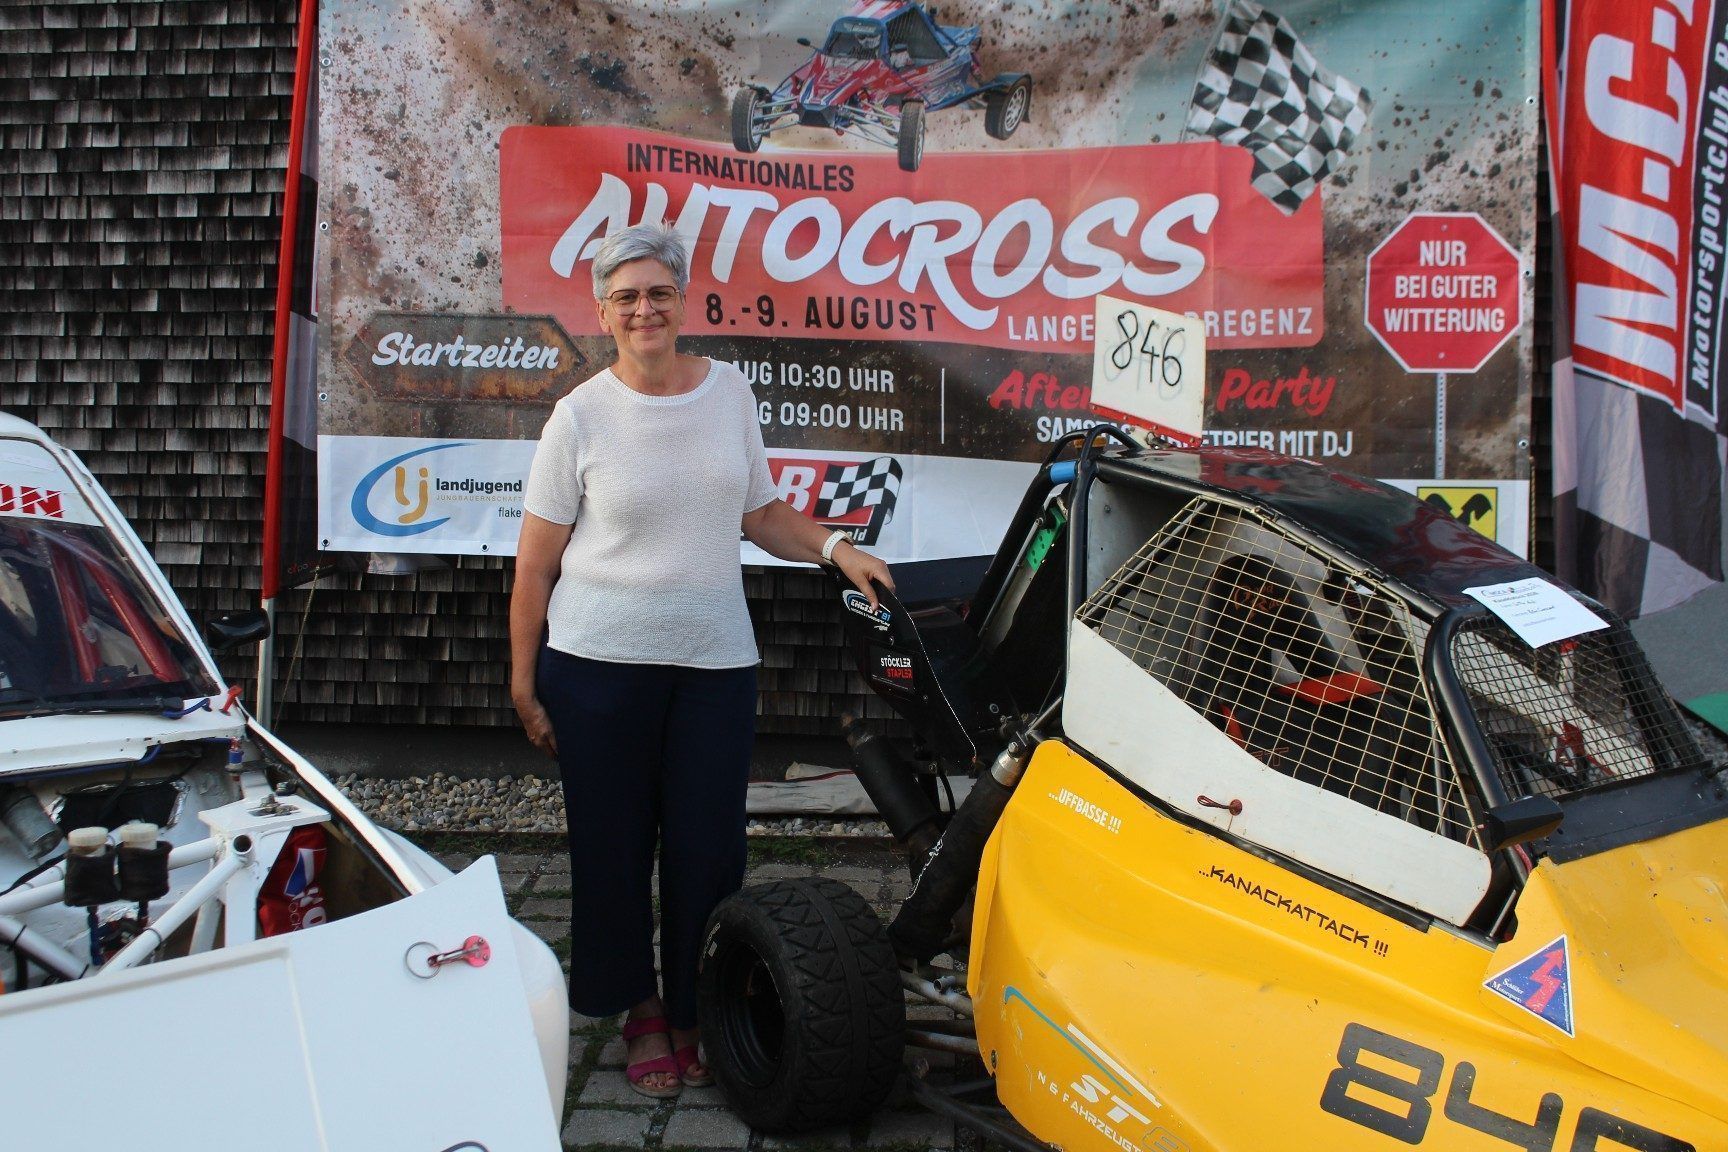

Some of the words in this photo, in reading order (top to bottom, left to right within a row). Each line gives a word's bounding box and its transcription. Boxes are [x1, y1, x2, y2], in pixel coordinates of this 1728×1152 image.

[627, 143, 855, 192] INTERNATIONALES
[549, 172, 1220, 330] AUTOCROSS
[1420, 240, 1467, 267] NUR
[1395, 275, 1427, 299] BEI
[1431, 275, 1498, 299] GUTER
[804, 296, 938, 332] AUGUST
[1007, 313, 1095, 342] LANGE
[1383, 308, 1506, 333] WITTERUNG
[371, 331, 560, 370] Startzeiten
[1111, 310, 1185, 388] 846
[780, 363, 841, 389] 10:30
[849, 367, 895, 393] UHR
[1216, 365, 1337, 417] Party
[779, 402, 850, 429] 09:00
[858, 406, 904, 432] UHR
[1279, 430, 1319, 458] MIT
[1322, 430, 1353, 458] DJ
[436, 478, 522, 494] landjugend
[880, 655, 912, 668] STÖCKLER
[1320, 1022, 1698, 1152] 84
